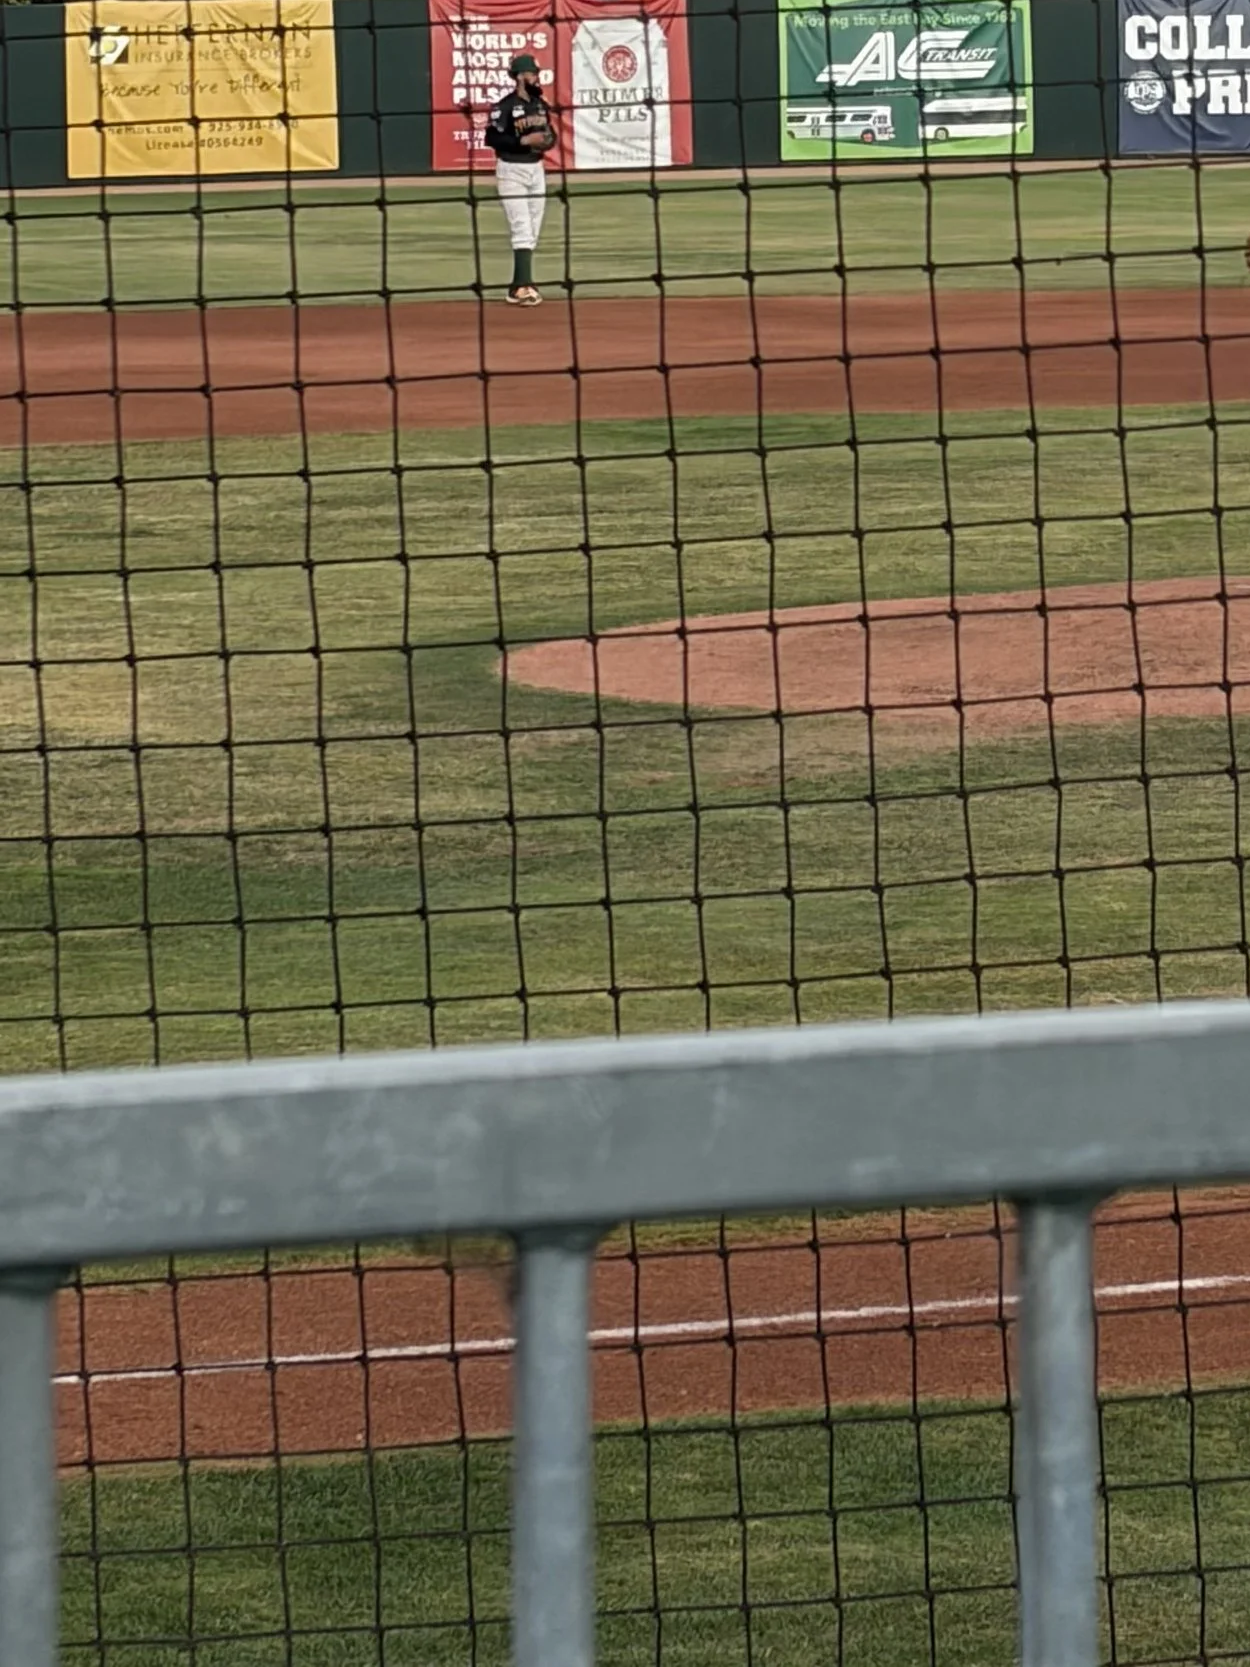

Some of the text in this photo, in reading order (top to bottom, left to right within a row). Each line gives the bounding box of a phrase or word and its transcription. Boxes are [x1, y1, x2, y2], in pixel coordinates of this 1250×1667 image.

[794, 14, 849, 30] Movng
[853, 14, 877, 26] the
[880, 13, 910, 26] East
[942, 13, 980, 25] Since
[451, 32, 547, 50] WORLD'S
[452, 51, 513, 68] MOST
[923, 47, 998, 62] TRANSIT
[452, 69, 554, 86] AWARD
[172, 79, 219, 95] Yo're
[597, 107, 648, 123] PILS
